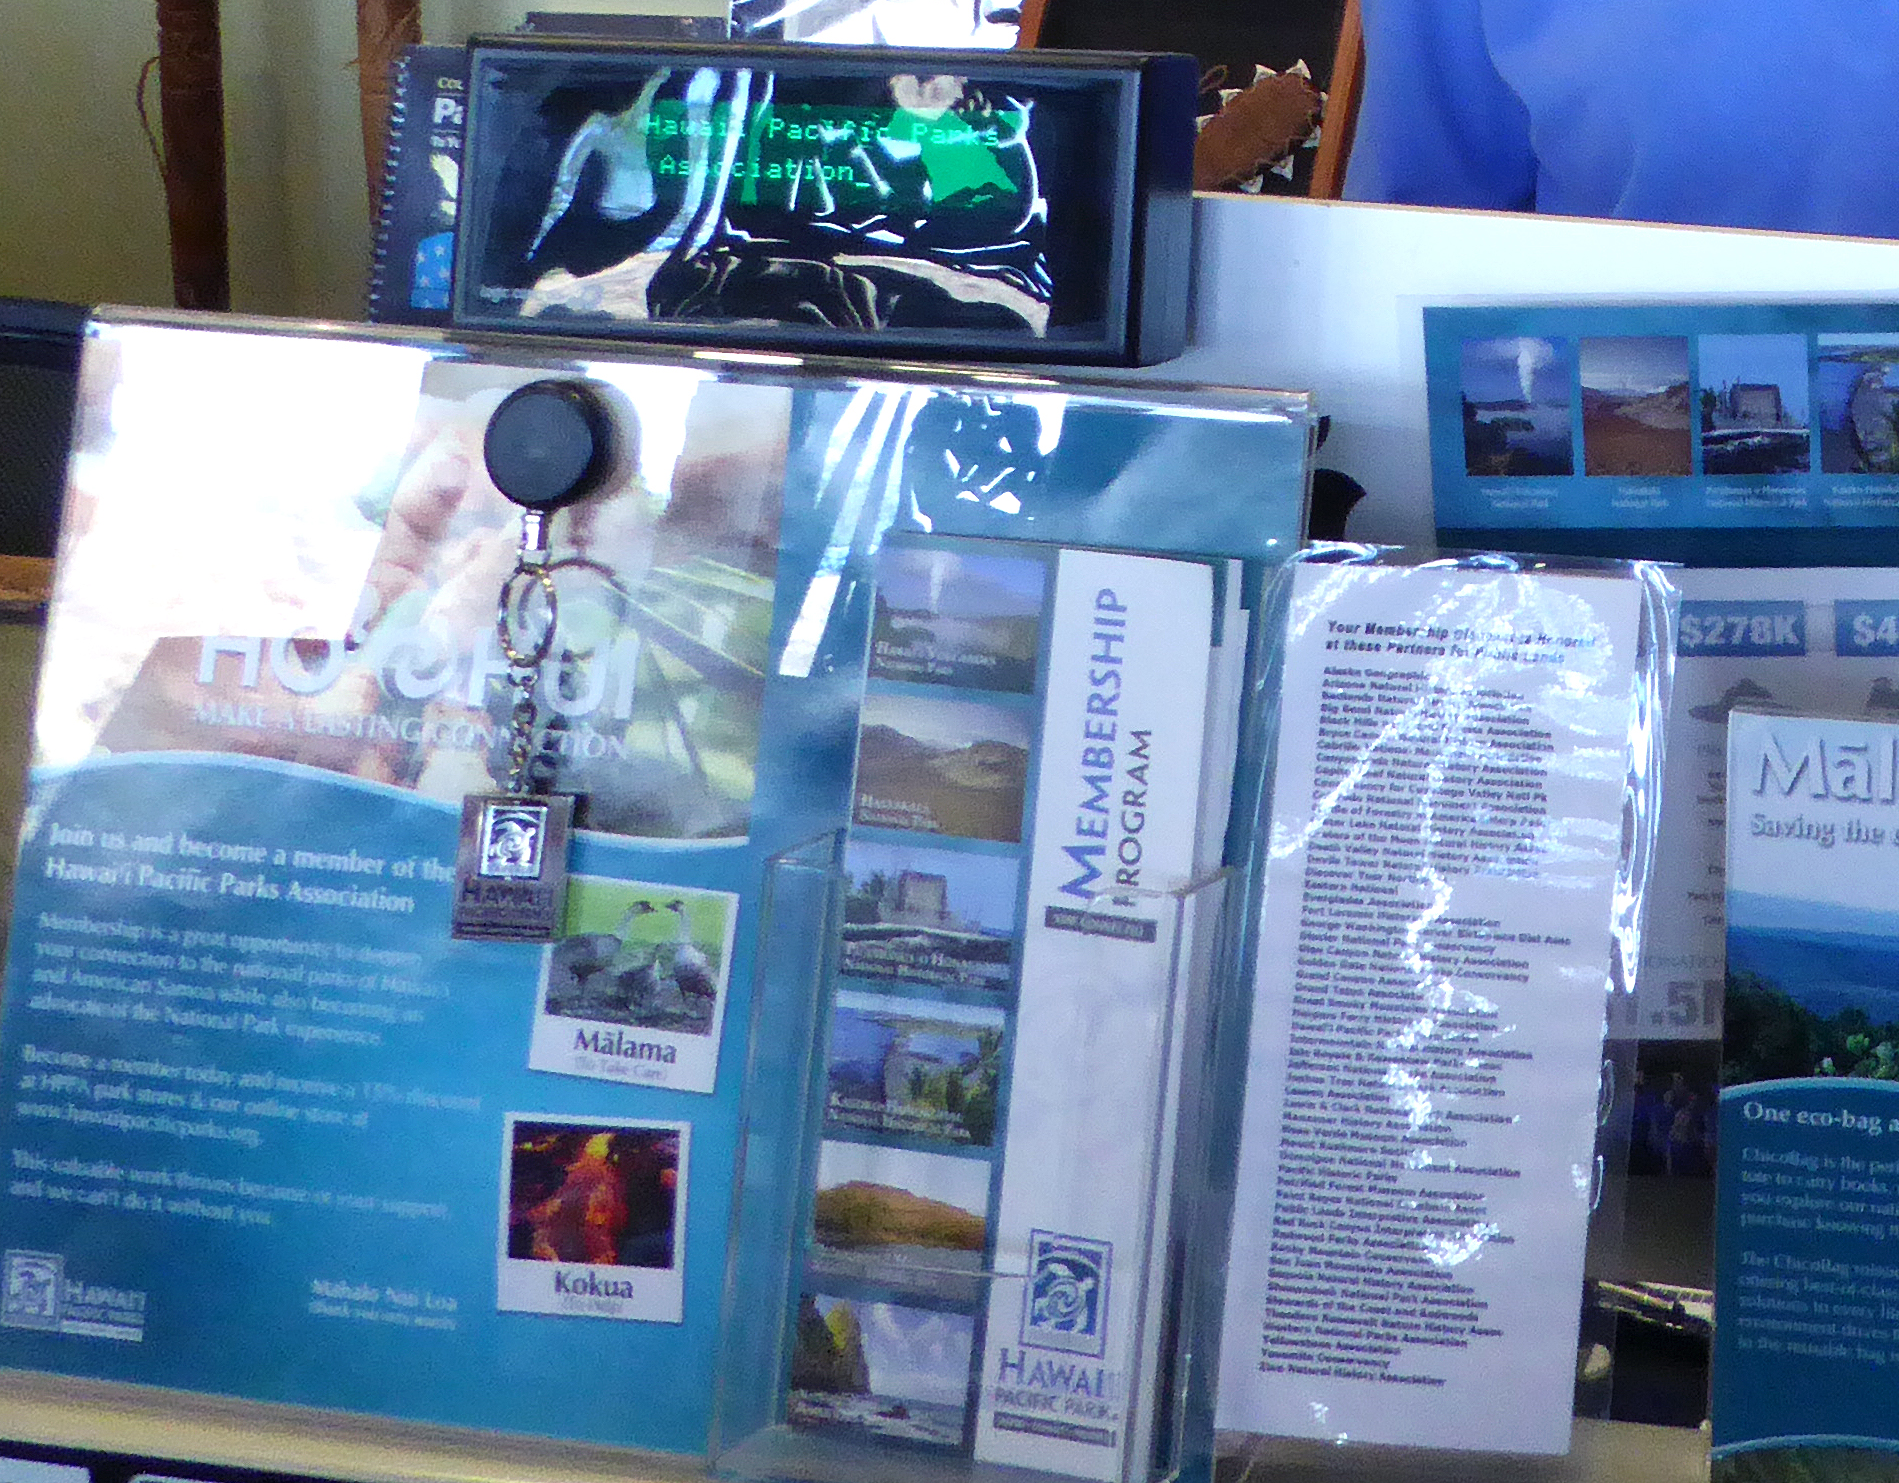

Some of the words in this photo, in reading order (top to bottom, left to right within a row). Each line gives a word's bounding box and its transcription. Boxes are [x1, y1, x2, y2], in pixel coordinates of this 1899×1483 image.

[769, 121, 890, 143] Pacific
[911, 123, 1000, 147] Parks
[1328, 620, 1361, 636] Your
[1680, 611, 1803, 647] $278K
[1325, 640, 1344, 652] at
[1386, 641, 1445, 658] Partners
[1059, 588, 1128, 901] MEMBERSHIP
[1112, 729, 1152, 907] PROGRAM
[1750, 814, 1835, 847] Saving
[1841, 819, 1885, 846] the
[51, 823, 95, 848] Join
[100, 832, 126, 849] us
[131, 832, 174, 856] and
[180, 837, 268, 864] become
[273, 848, 286, 866] a
[292, 849, 385, 876] member
[392, 856, 415, 879] of
[423, 857, 457, 884] the
[139, 863, 211, 894] Pacific
[220, 872, 280, 900] Parks
[288, 880, 415, 914] Association
[574, 1028, 678, 1064] Mālama
[1743, 1101, 1790, 1122] One
[1796, 1108, 1882, 1136] eco-bag
[554, 1271, 634, 1300] Kokua
